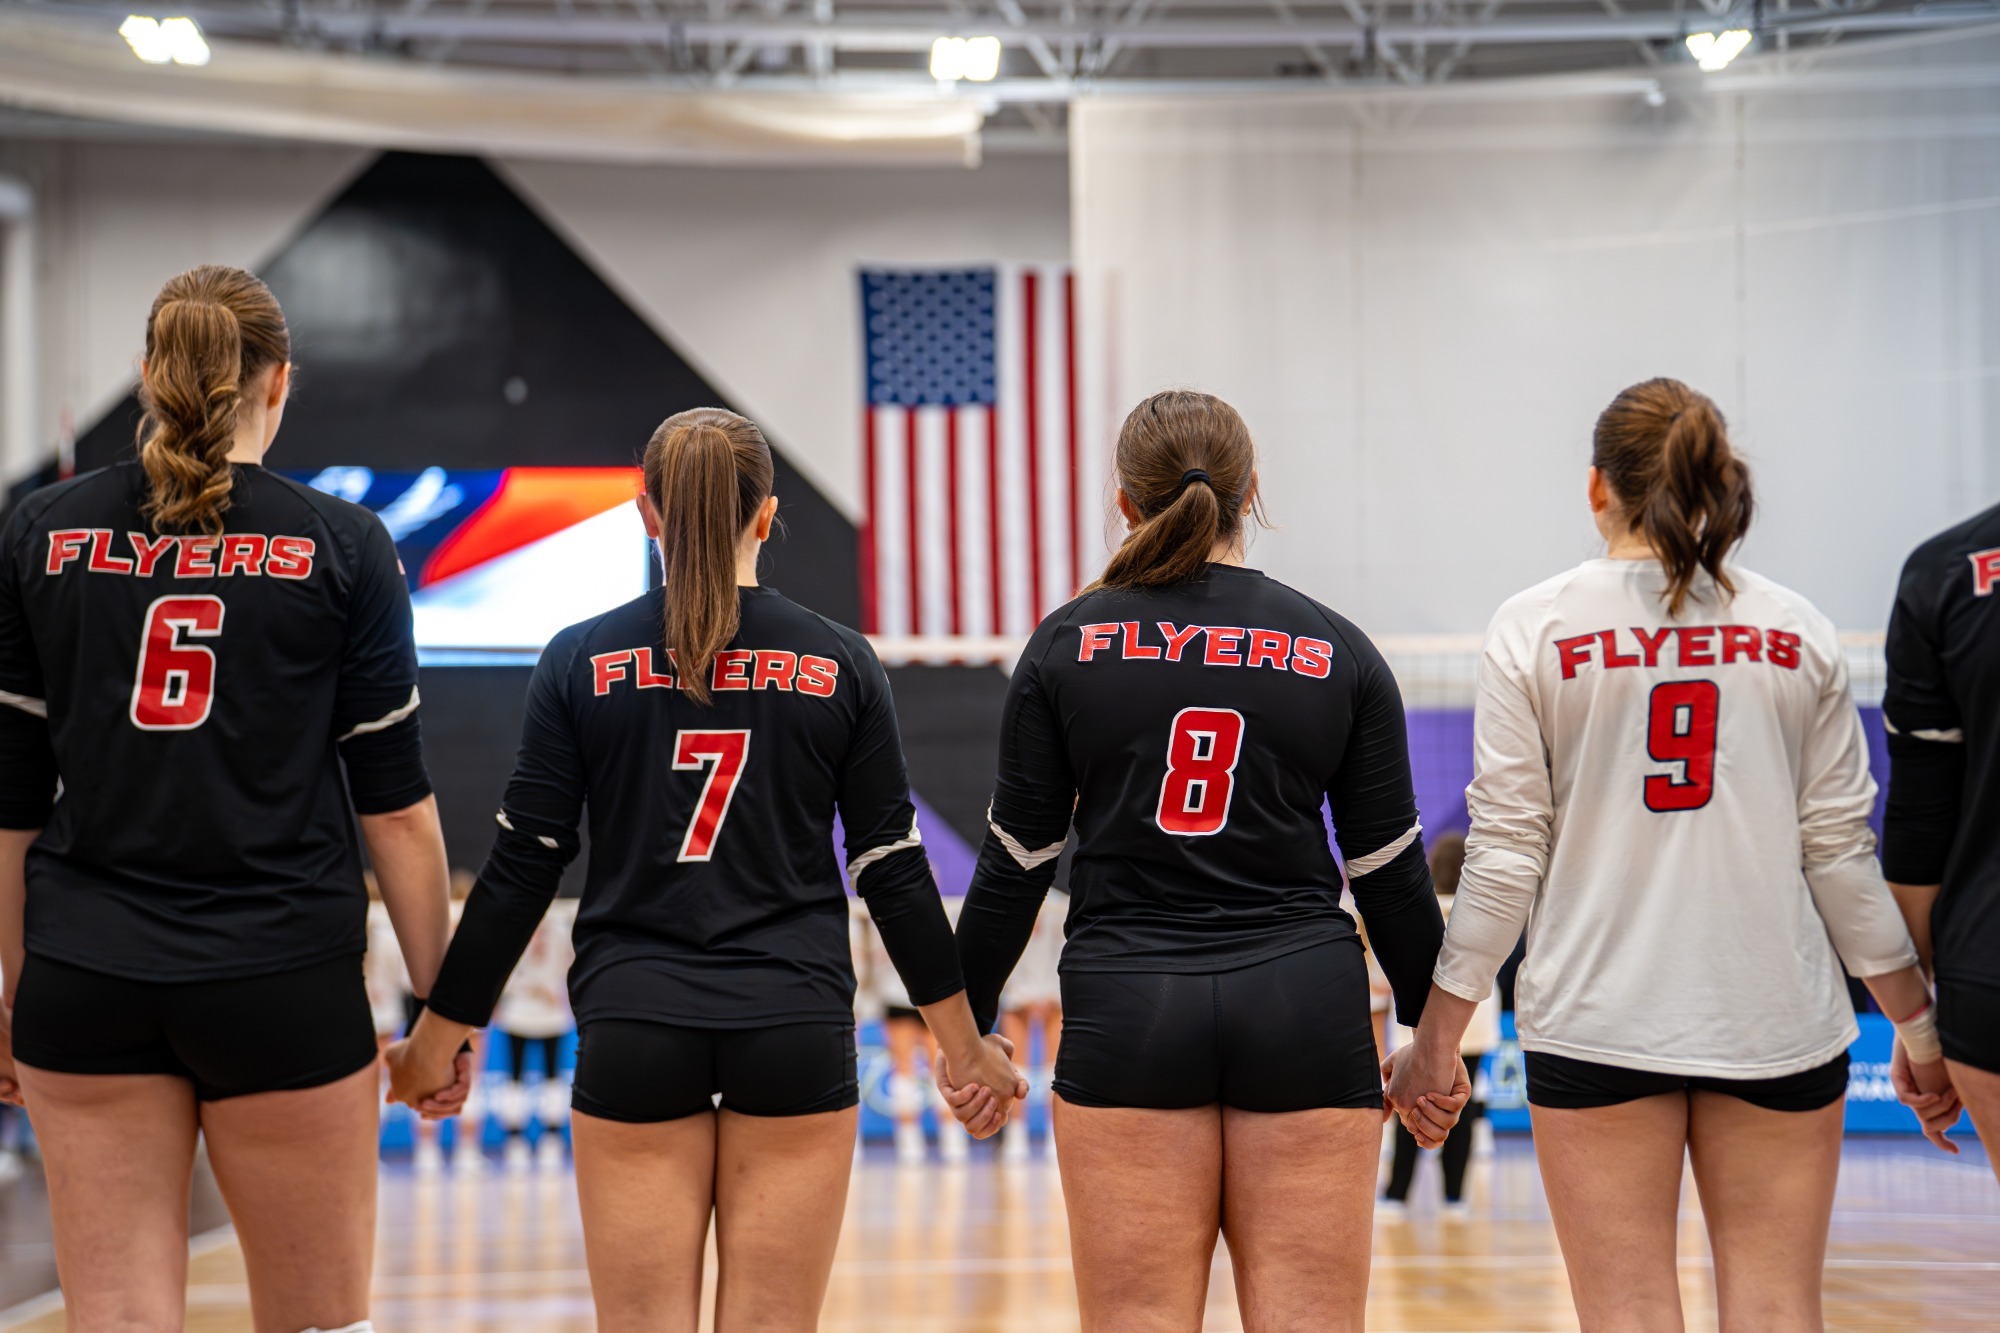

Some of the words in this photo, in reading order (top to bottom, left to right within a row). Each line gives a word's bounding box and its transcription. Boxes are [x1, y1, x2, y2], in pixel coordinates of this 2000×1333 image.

[46, 528, 316, 580] FLYERS
[129, 594, 226, 732] 6
[1078, 621, 1334, 679] FLYERS
[1553, 624, 1801, 681] FLYERS
[671, 729, 752, 863] 7
[1155, 706, 1246, 836] 8
[1643, 679, 1720, 814] 9
